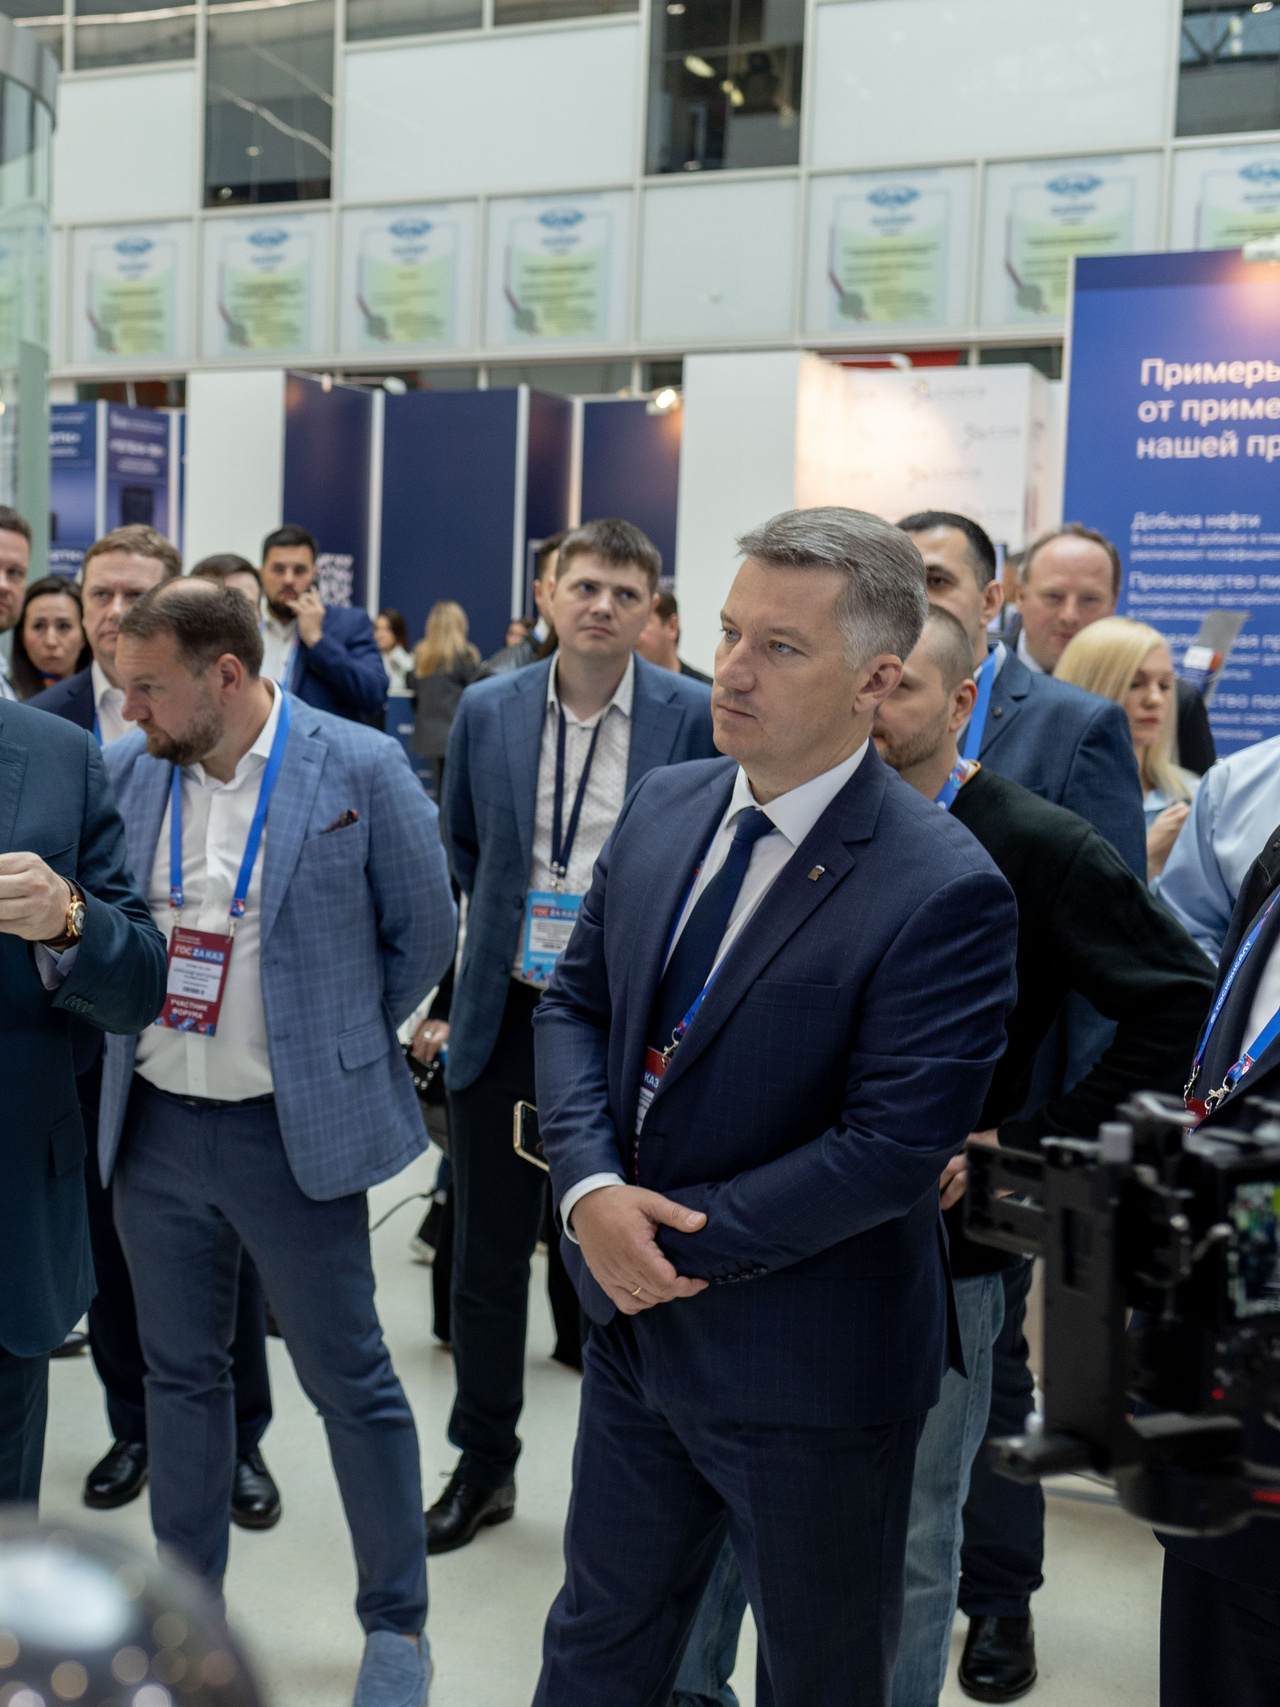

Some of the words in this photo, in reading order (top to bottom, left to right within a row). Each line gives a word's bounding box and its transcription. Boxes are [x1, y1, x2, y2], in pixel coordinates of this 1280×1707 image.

[1137, 399, 1175, 423] от
[1181, 397, 1280, 427] приме
[1136, 430, 1238, 459] нашей
[1246, 434, 1280, 463] пр
[1128, 571, 1257, 592] Производство
[1216, 941, 1251, 1010] ГОСКОНСАЛТ
[643, 1071, 660, 1088] КАЗ
